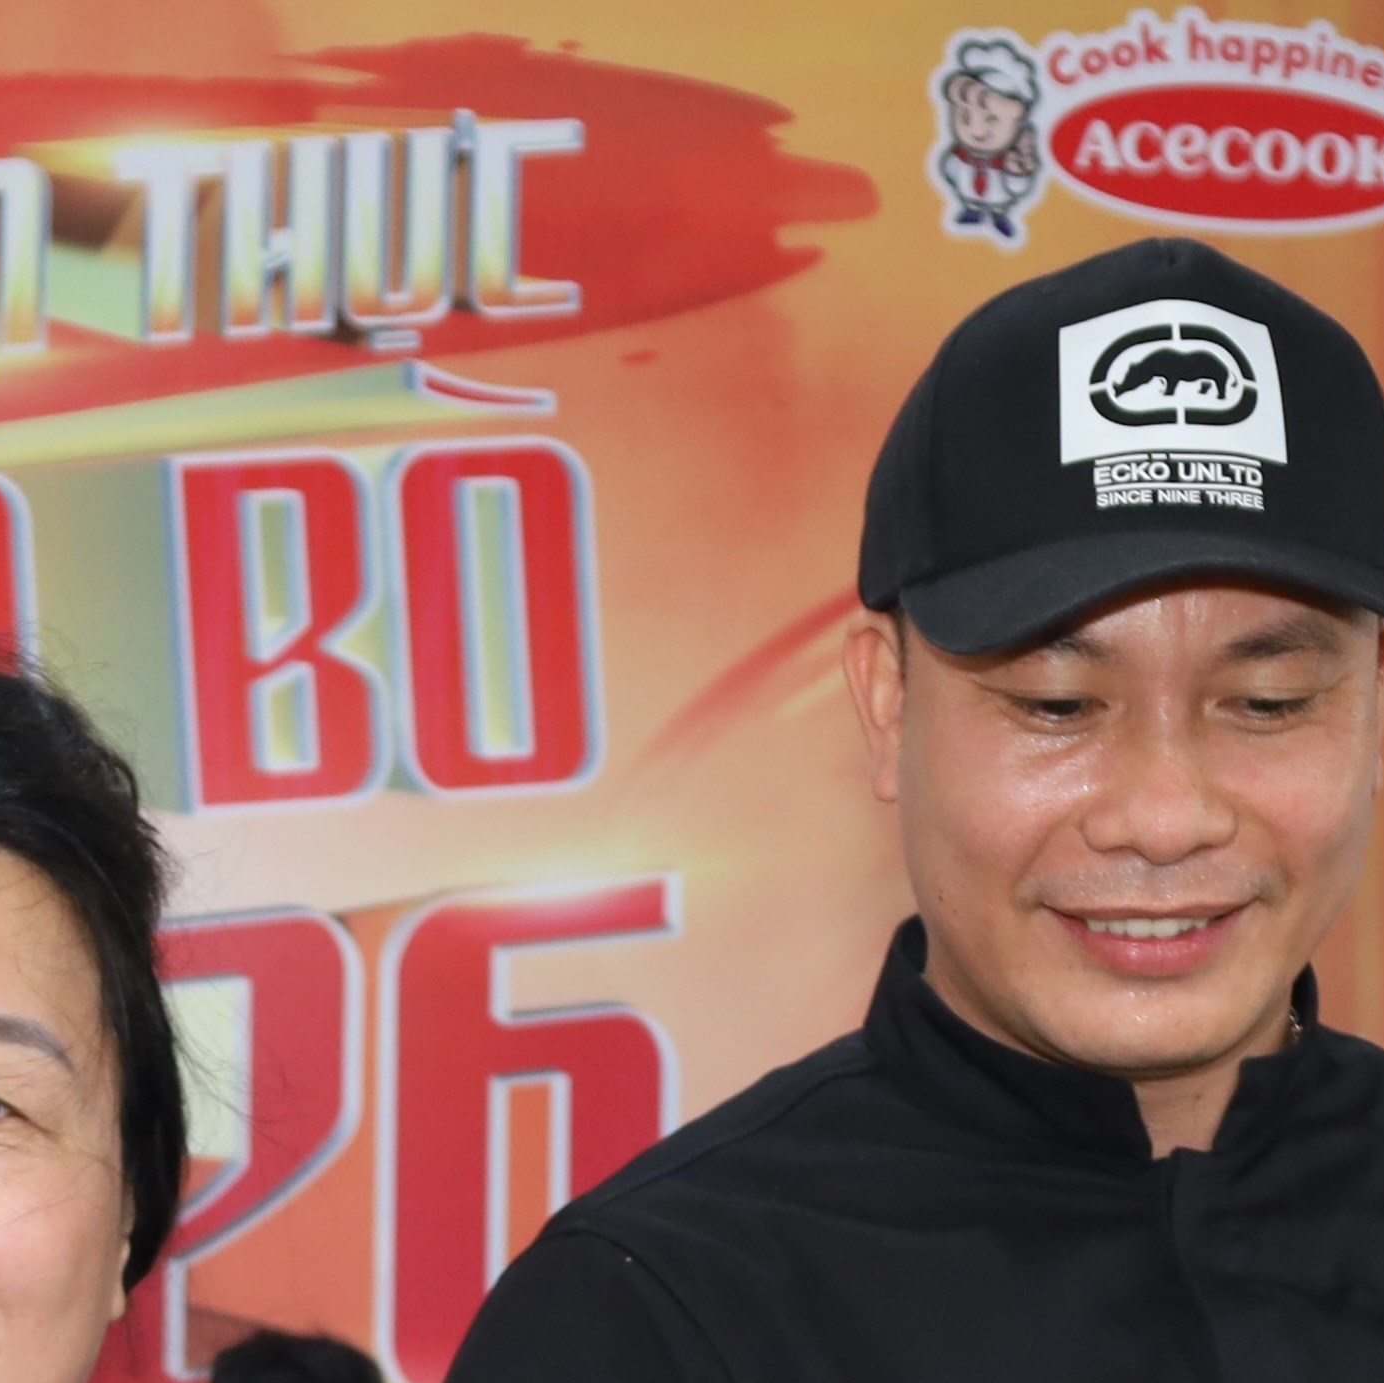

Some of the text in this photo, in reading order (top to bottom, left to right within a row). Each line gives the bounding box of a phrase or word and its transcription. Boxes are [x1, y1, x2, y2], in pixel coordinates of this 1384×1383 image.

[1047, 20, 1170, 86] Cook
[1177, 460, 1265, 488] UNLTD
[1095, 488, 1265, 512] SINCE NINE THREE
[164, 360, 606, 815] BÒ
